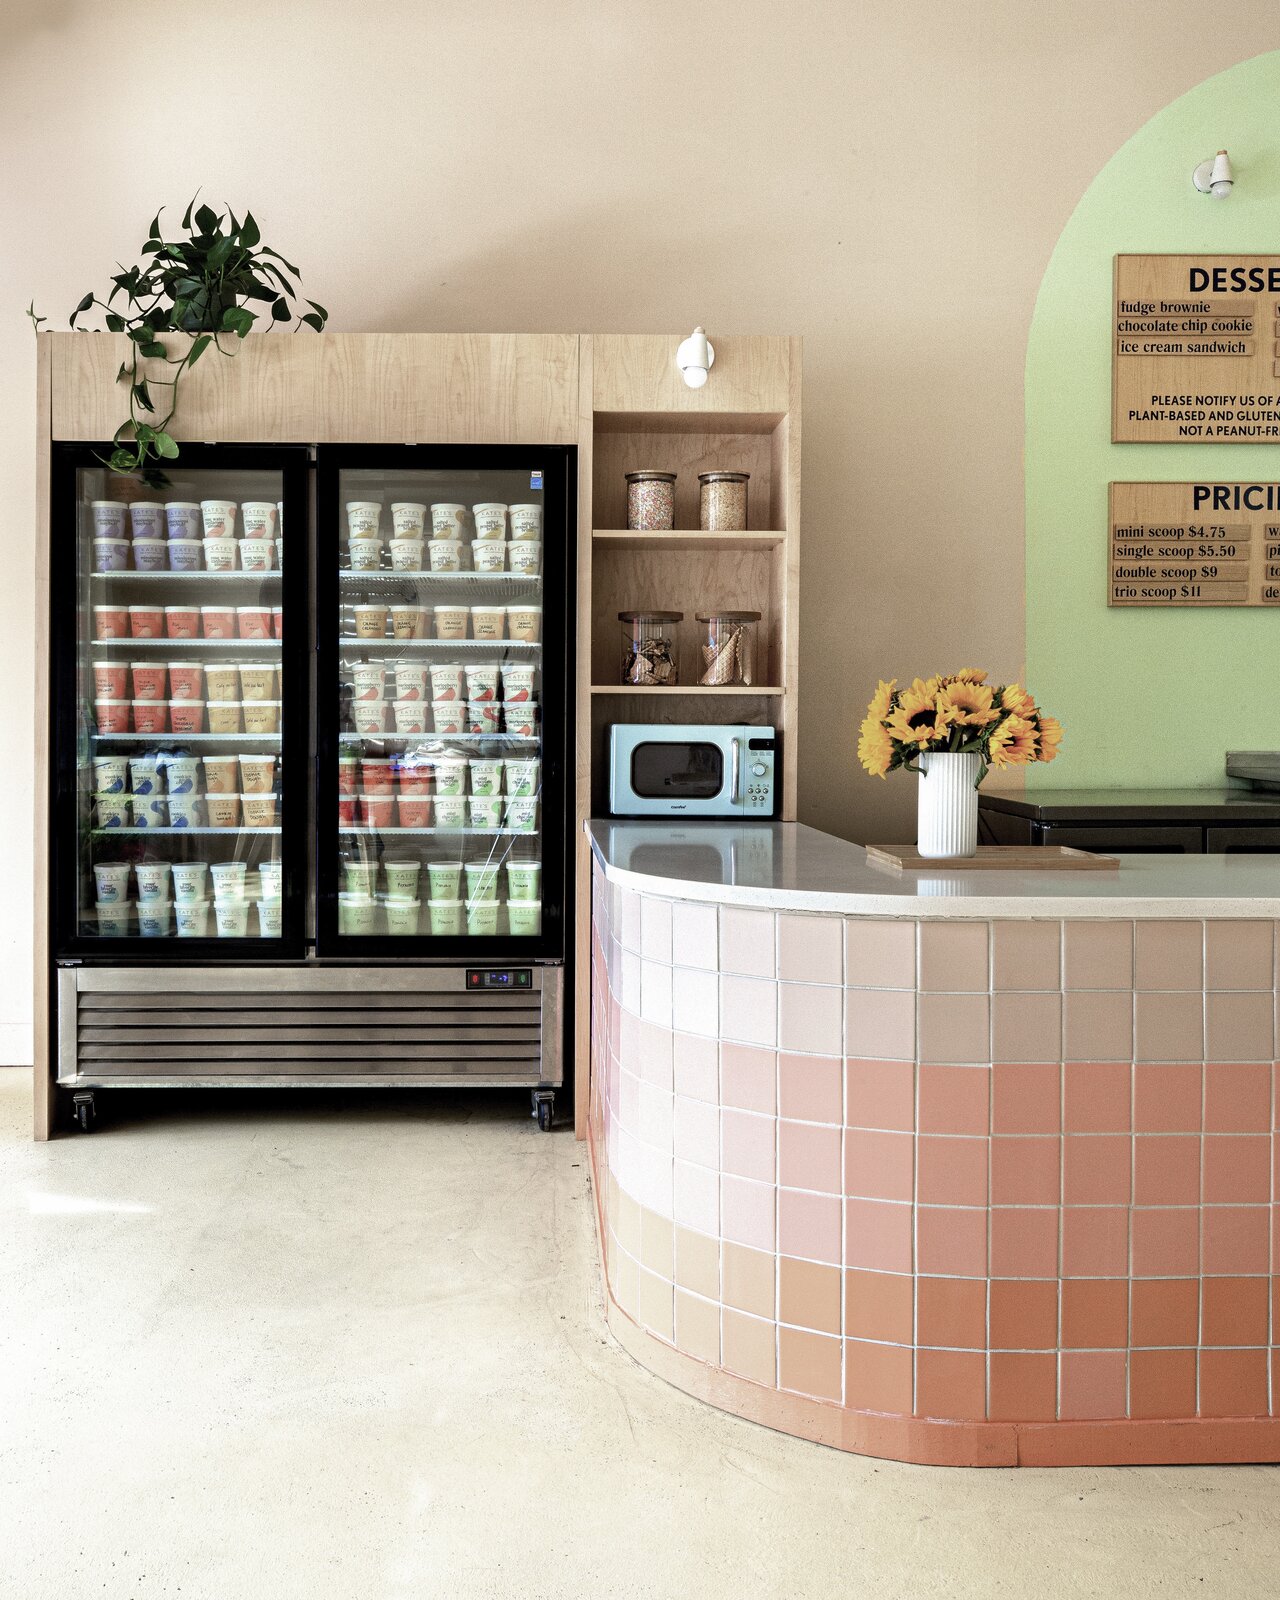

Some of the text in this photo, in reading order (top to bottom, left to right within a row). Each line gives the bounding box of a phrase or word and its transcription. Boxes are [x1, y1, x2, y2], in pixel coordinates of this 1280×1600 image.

[1120, 301, 1211, 316] fudge brownie
[1117, 319, 1253, 333] chocolate chip cookie
[1120, 340, 1246, 354] ice cream sandwich
[1151, 395, 1192, 406] PLEASE
[1195, 395, 1237, 406] NOTIFY
[1239, 395, 1255, 406] US
[1258, 395, 1274, 406] OF
[1129, 410, 1206, 421] PLANT-BASED
[1208, 410, 1234, 421] AND
[1179, 425, 1203, 436] NOT
[1206, 425, 1214, 436] A
[1193, 485, 1280, 511] PRICI
[1117, 525, 1226, 540] mini scoop $4.75
[1269, 527, 1280, 537] w
[1116, 544, 1236, 560] single scoop $5.50
[1115, 565, 1218, 581] double scoop $9
[1115, 585, 1201, 600] trio scoop $11
